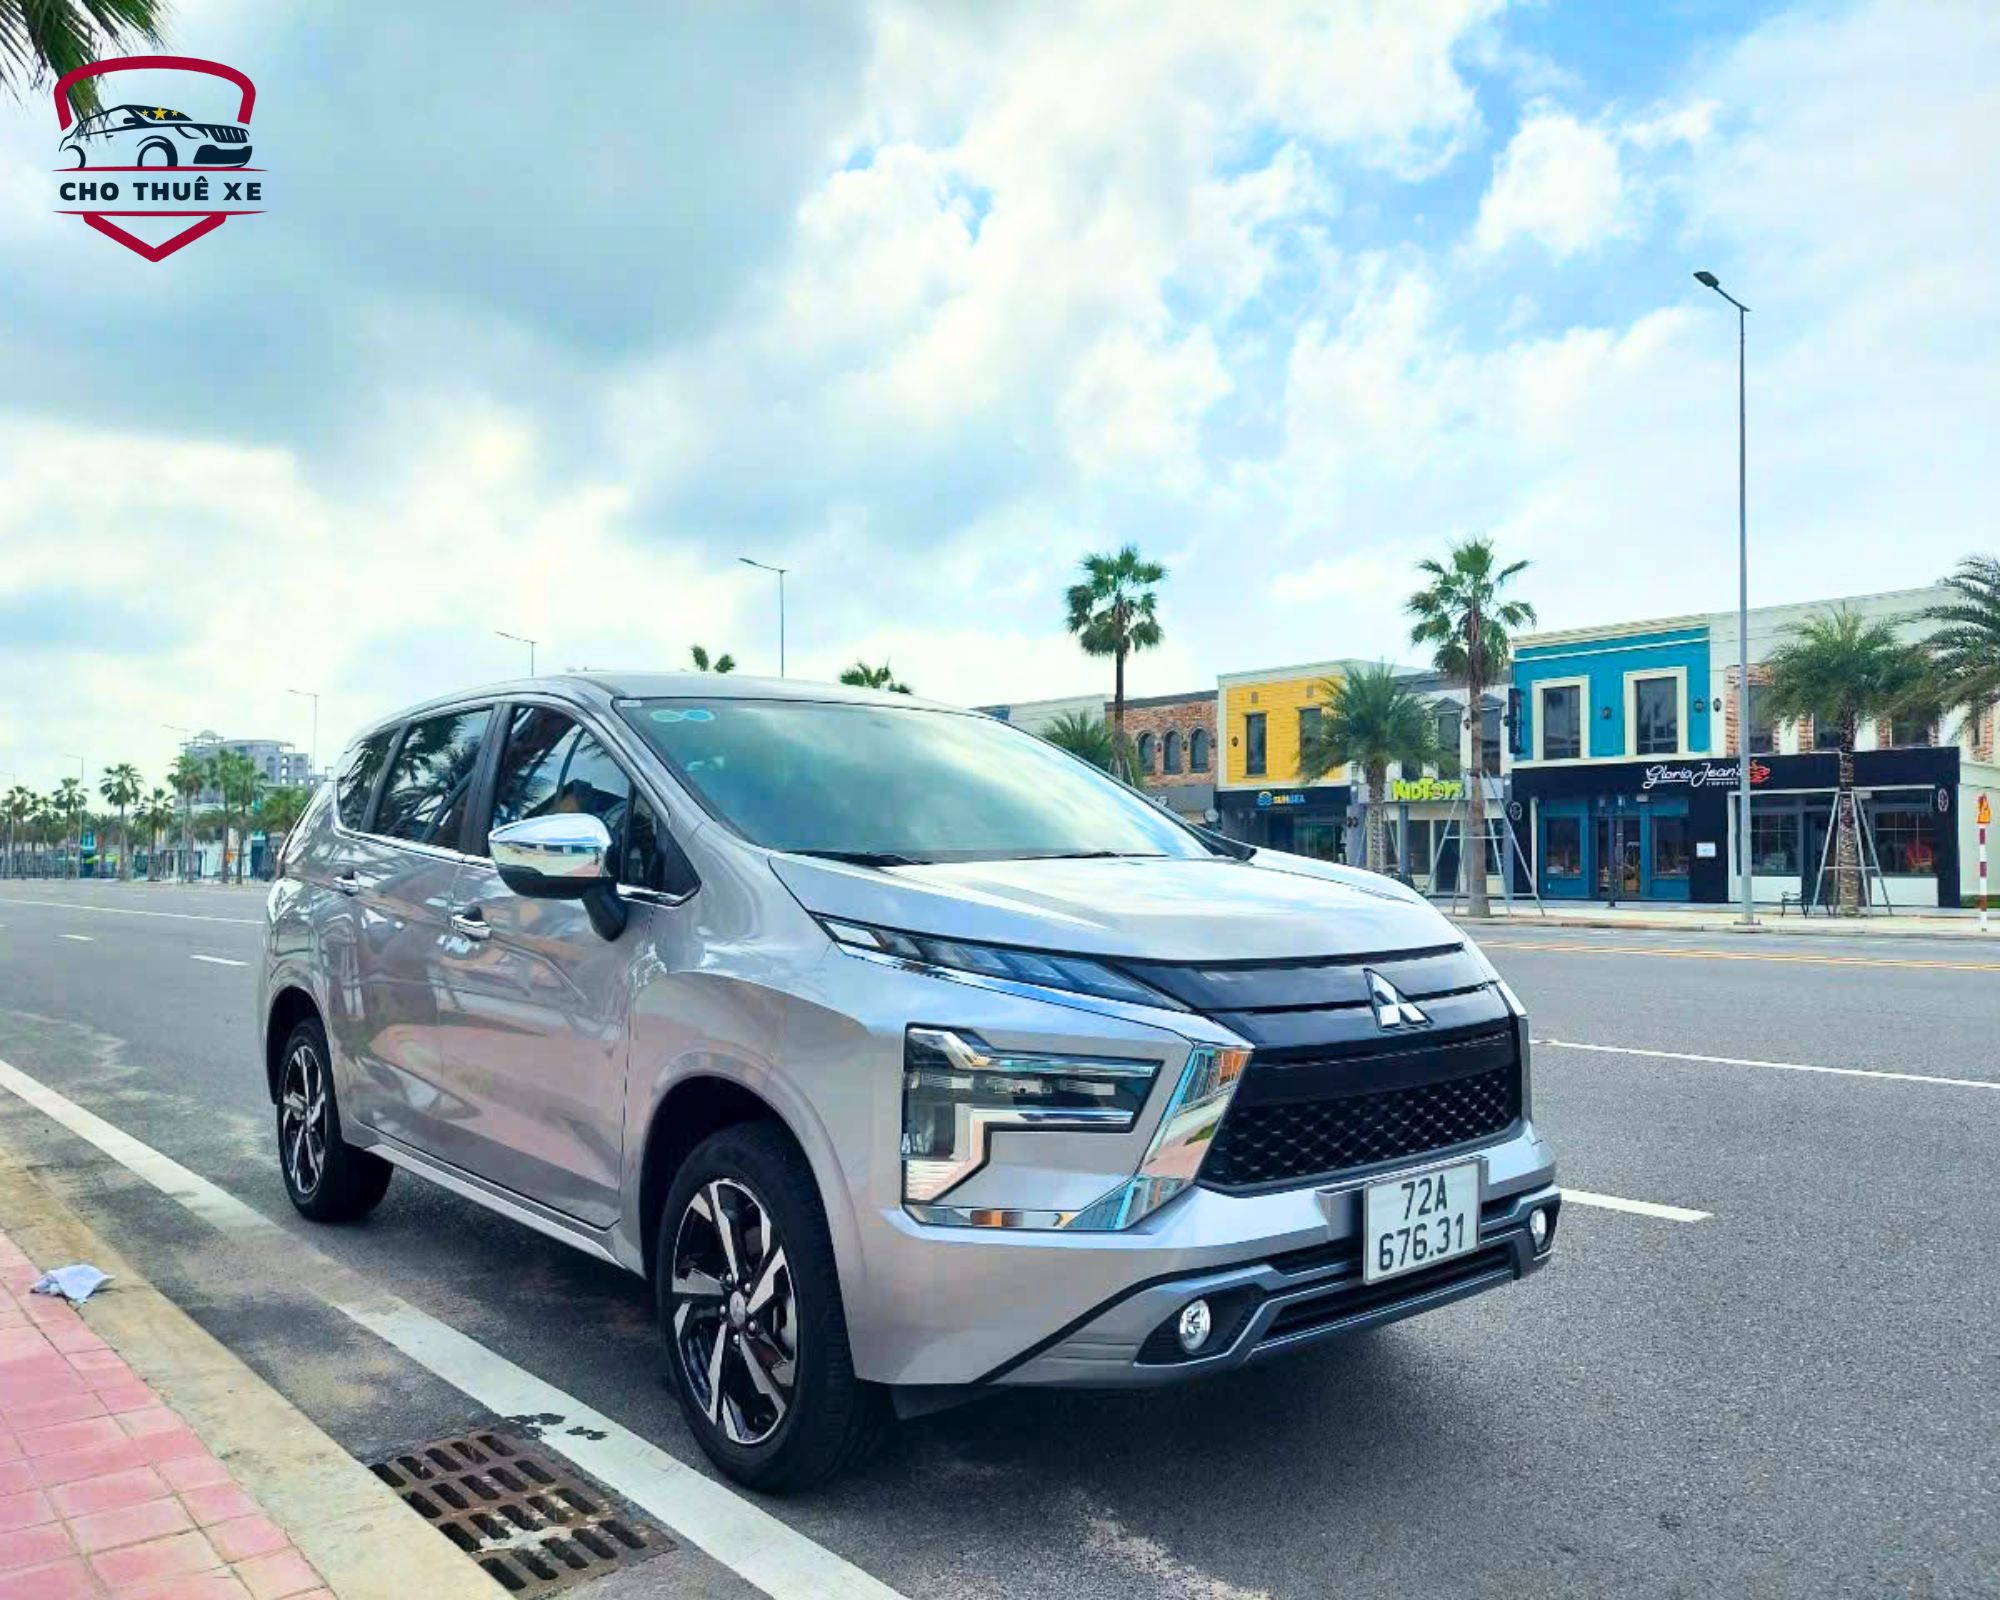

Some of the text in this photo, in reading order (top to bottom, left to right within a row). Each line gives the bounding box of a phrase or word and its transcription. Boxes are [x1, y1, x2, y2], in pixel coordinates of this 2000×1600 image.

[1642, 764, 1693, 789] Gloria
[1401, 1174, 1447, 1220] 72A
[1379, 1213, 1464, 1271] 676.31
